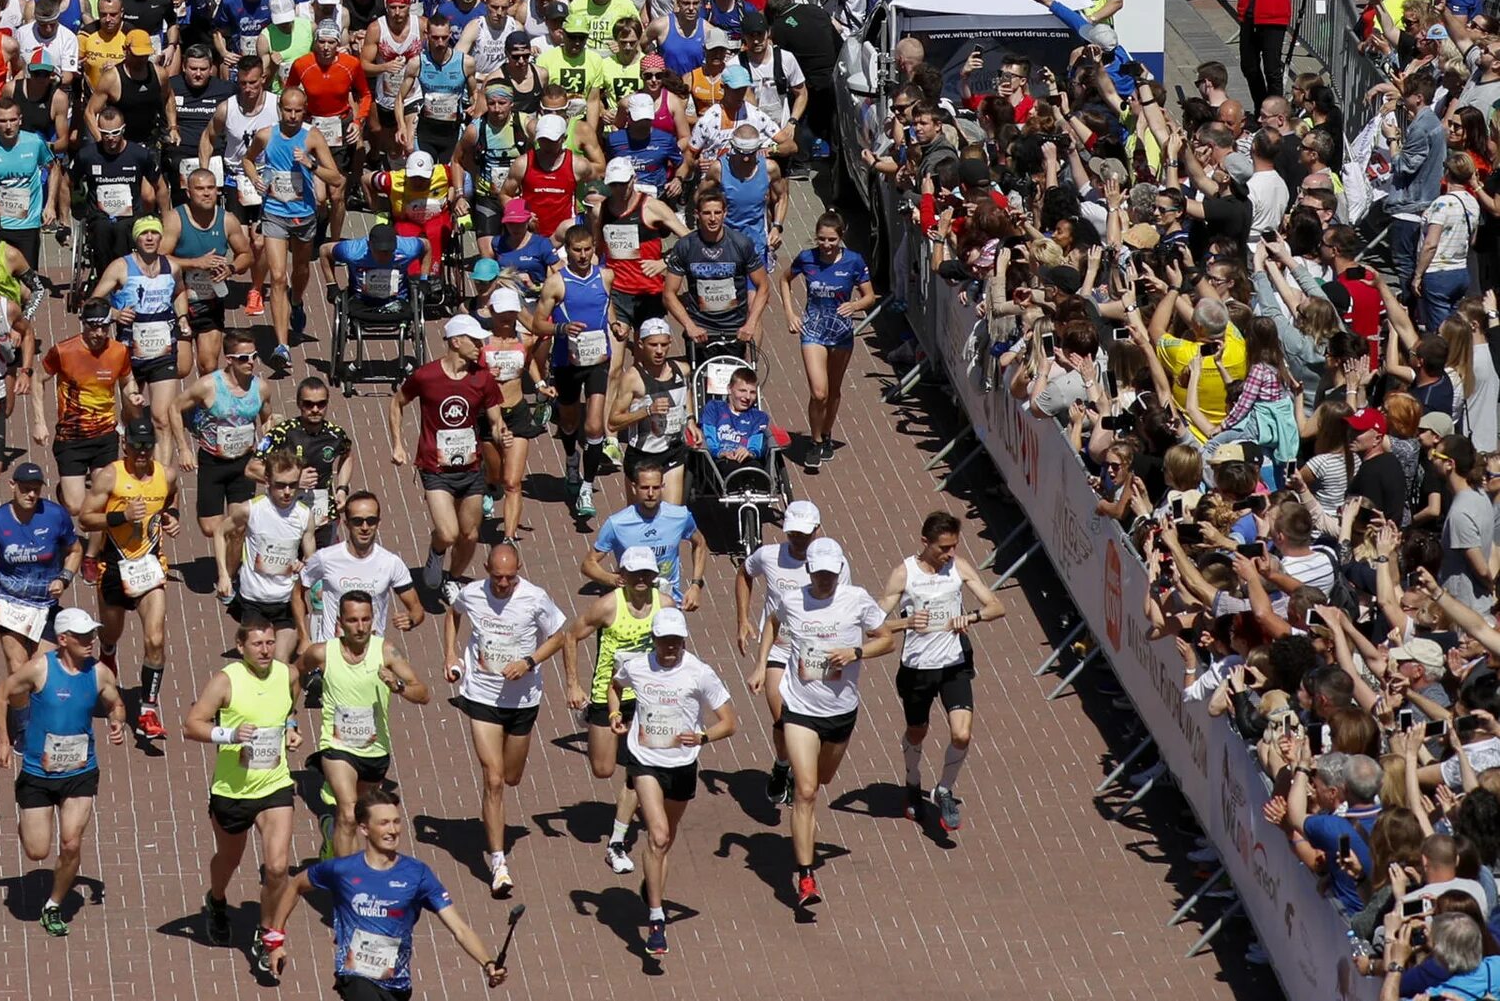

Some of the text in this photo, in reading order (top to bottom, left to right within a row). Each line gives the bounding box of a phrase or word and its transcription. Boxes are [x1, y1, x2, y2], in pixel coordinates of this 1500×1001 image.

[928, 30, 1070, 40] www.wingsforlifeworldrun.com
[0, 200, 23, 209] 51974
[10, 553, 38, 563] WORLD
[483, 621, 514, 631] Benecol
[804, 625, 837, 634] Benecol
[646, 687, 677, 697] Benecol
[340, 726, 371, 735] 44386
[645, 725, 673, 735] 86261
[50, 753, 81, 762] 48732
[359, 906, 388, 917] WORLD
[355, 952, 388, 967] 51174
